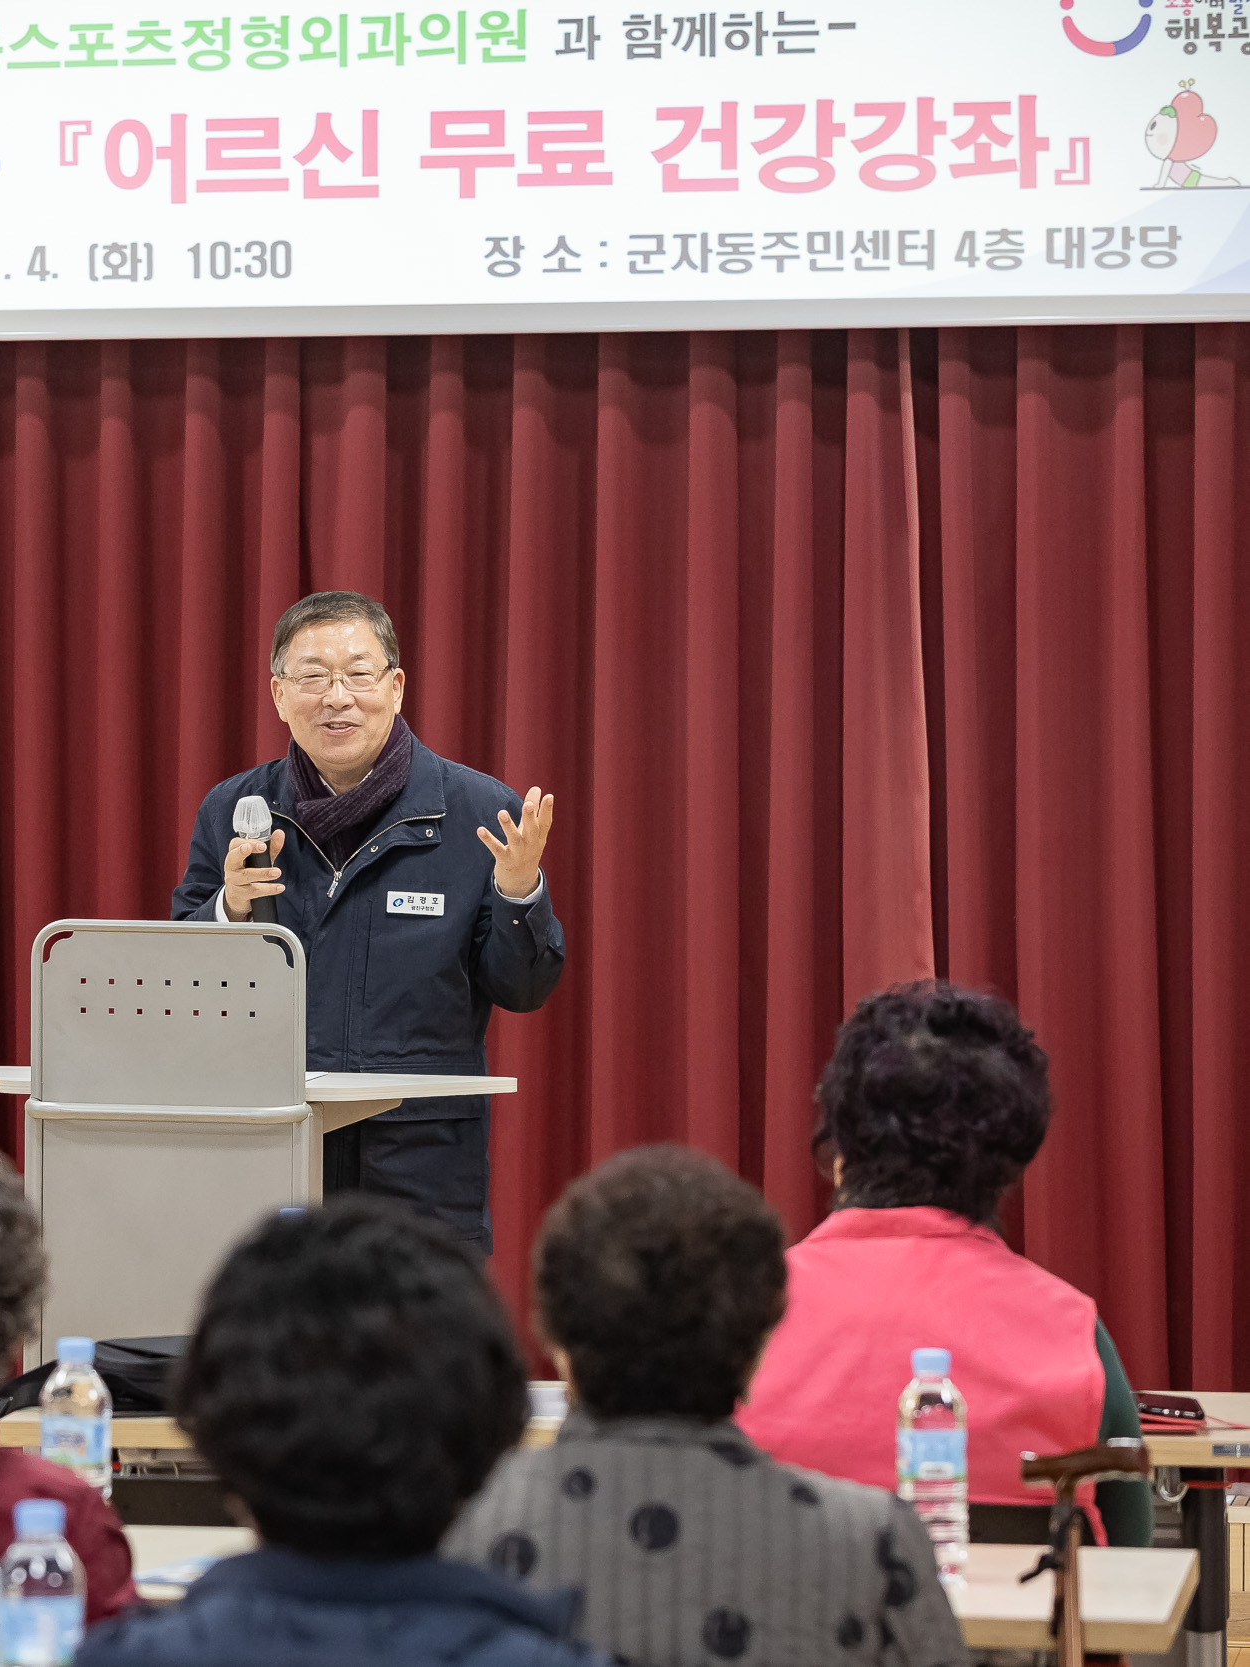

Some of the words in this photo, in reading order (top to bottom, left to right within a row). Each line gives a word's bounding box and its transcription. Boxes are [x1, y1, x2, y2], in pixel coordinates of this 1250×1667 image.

[554, 15, 602, 61] 과
[420, 109, 613, 199] 무료
[26, 245, 59, 283] 4.
[187, 240, 293, 280] 10:30
[627, 229, 937, 276] 군자동주민센터
[954, 228, 1025, 271] 4층
[1046, 225, 1182, 270] 대강당
